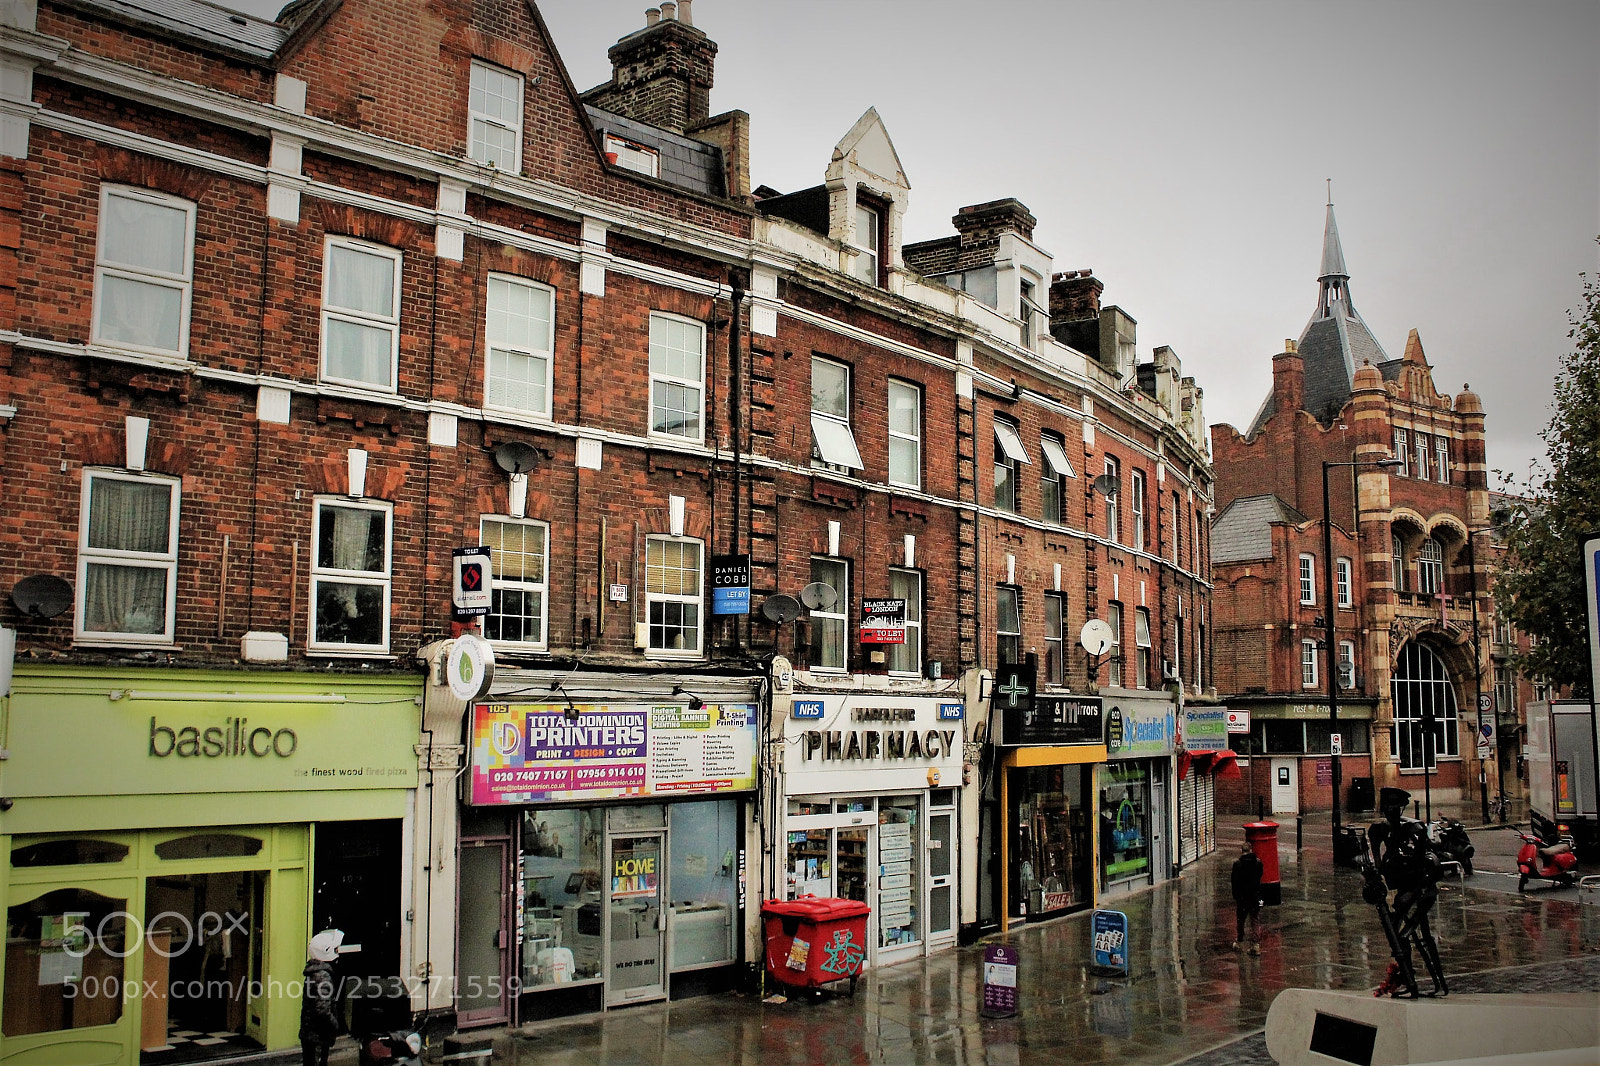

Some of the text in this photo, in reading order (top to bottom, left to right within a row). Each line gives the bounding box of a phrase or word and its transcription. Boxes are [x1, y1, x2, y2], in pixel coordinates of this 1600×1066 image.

[716, 575, 746, 584] COBB
[488, 705, 507, 713] 105
[799, 704, 820, 716] NHS
[944, 706, 960, 717] NHS
[1054, 702, 1060, 715] &
[1316, 704, 1342, 712] t-ros
[529, 715, 644, 728] TOTAL DOMINION
[716, 719, 744, 728] Printing
[148, 716, 298, 758] basilico
[530, 725, 645, 747] PRINTERS
[802, 730, 956, 761] PHARMACY
[536, 747, 638, 759] PRINT DESIGN COPY
[312, 768, 336, 776] finest
[339, 767, 363, 776] wood
[494, 767, 644, 782] 020 7407 7167 07956 914 610
[492, 779, 643, 792] sales@totaldominion.co.uk www.totaldominion.co.uk
[616, 858, 654, 876] HOME
